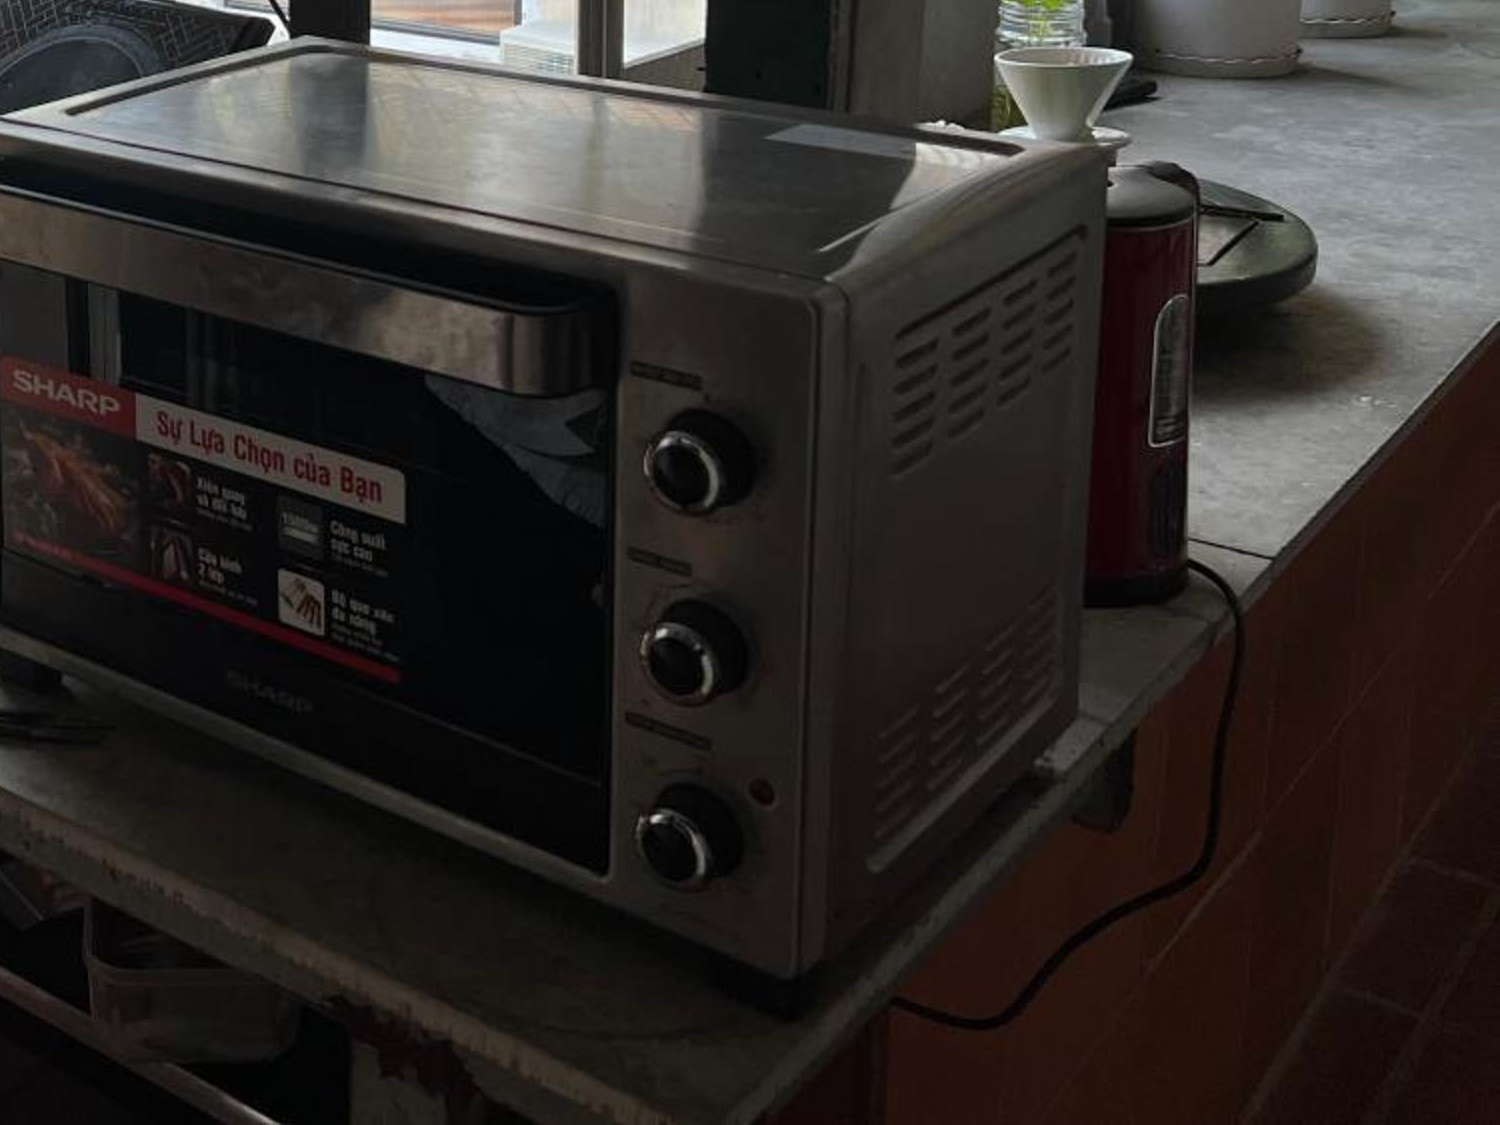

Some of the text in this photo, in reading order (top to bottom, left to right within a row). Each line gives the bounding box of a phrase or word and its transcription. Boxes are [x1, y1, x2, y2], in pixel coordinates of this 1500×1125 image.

[12, 368, 120, 417] SHARP
[157, 410, 383, 503] Sự Lựa Chọn của Bạn
